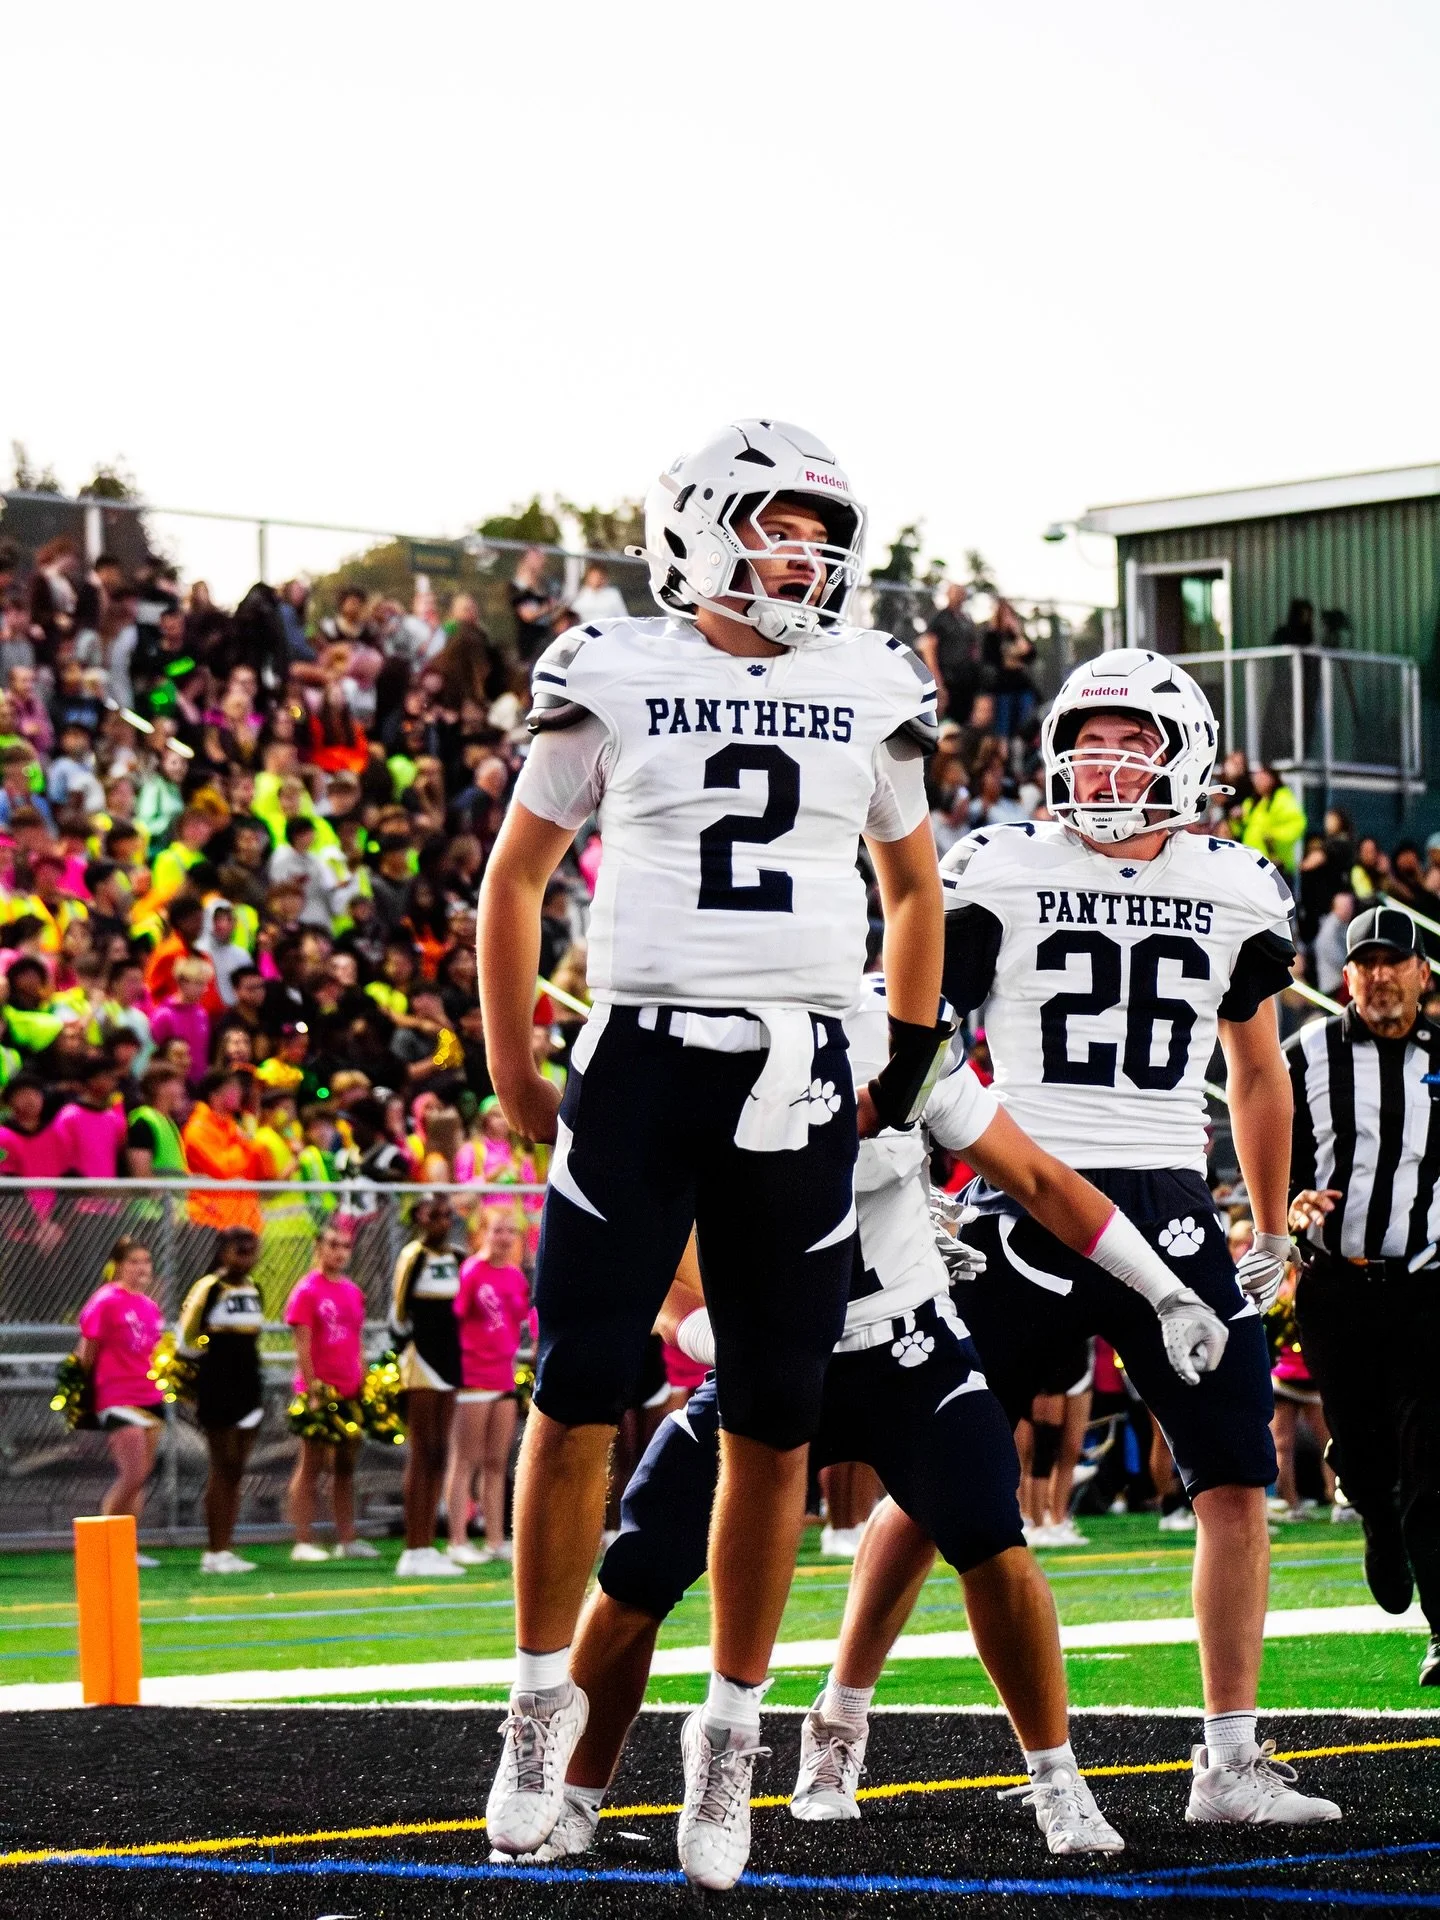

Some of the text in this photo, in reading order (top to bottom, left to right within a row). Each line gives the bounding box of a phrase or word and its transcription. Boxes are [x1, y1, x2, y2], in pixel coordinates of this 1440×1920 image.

[805, 470, 849, 492] Riddell
[1081, 687, 1128, 697] Riddell
[645, 697, 855, 744] PANTHERS
[697, 742, 801, 914] 2
[1036, 890, 1214, 935] PANTHERS
[1035, 929, 1211, 1091] 26
